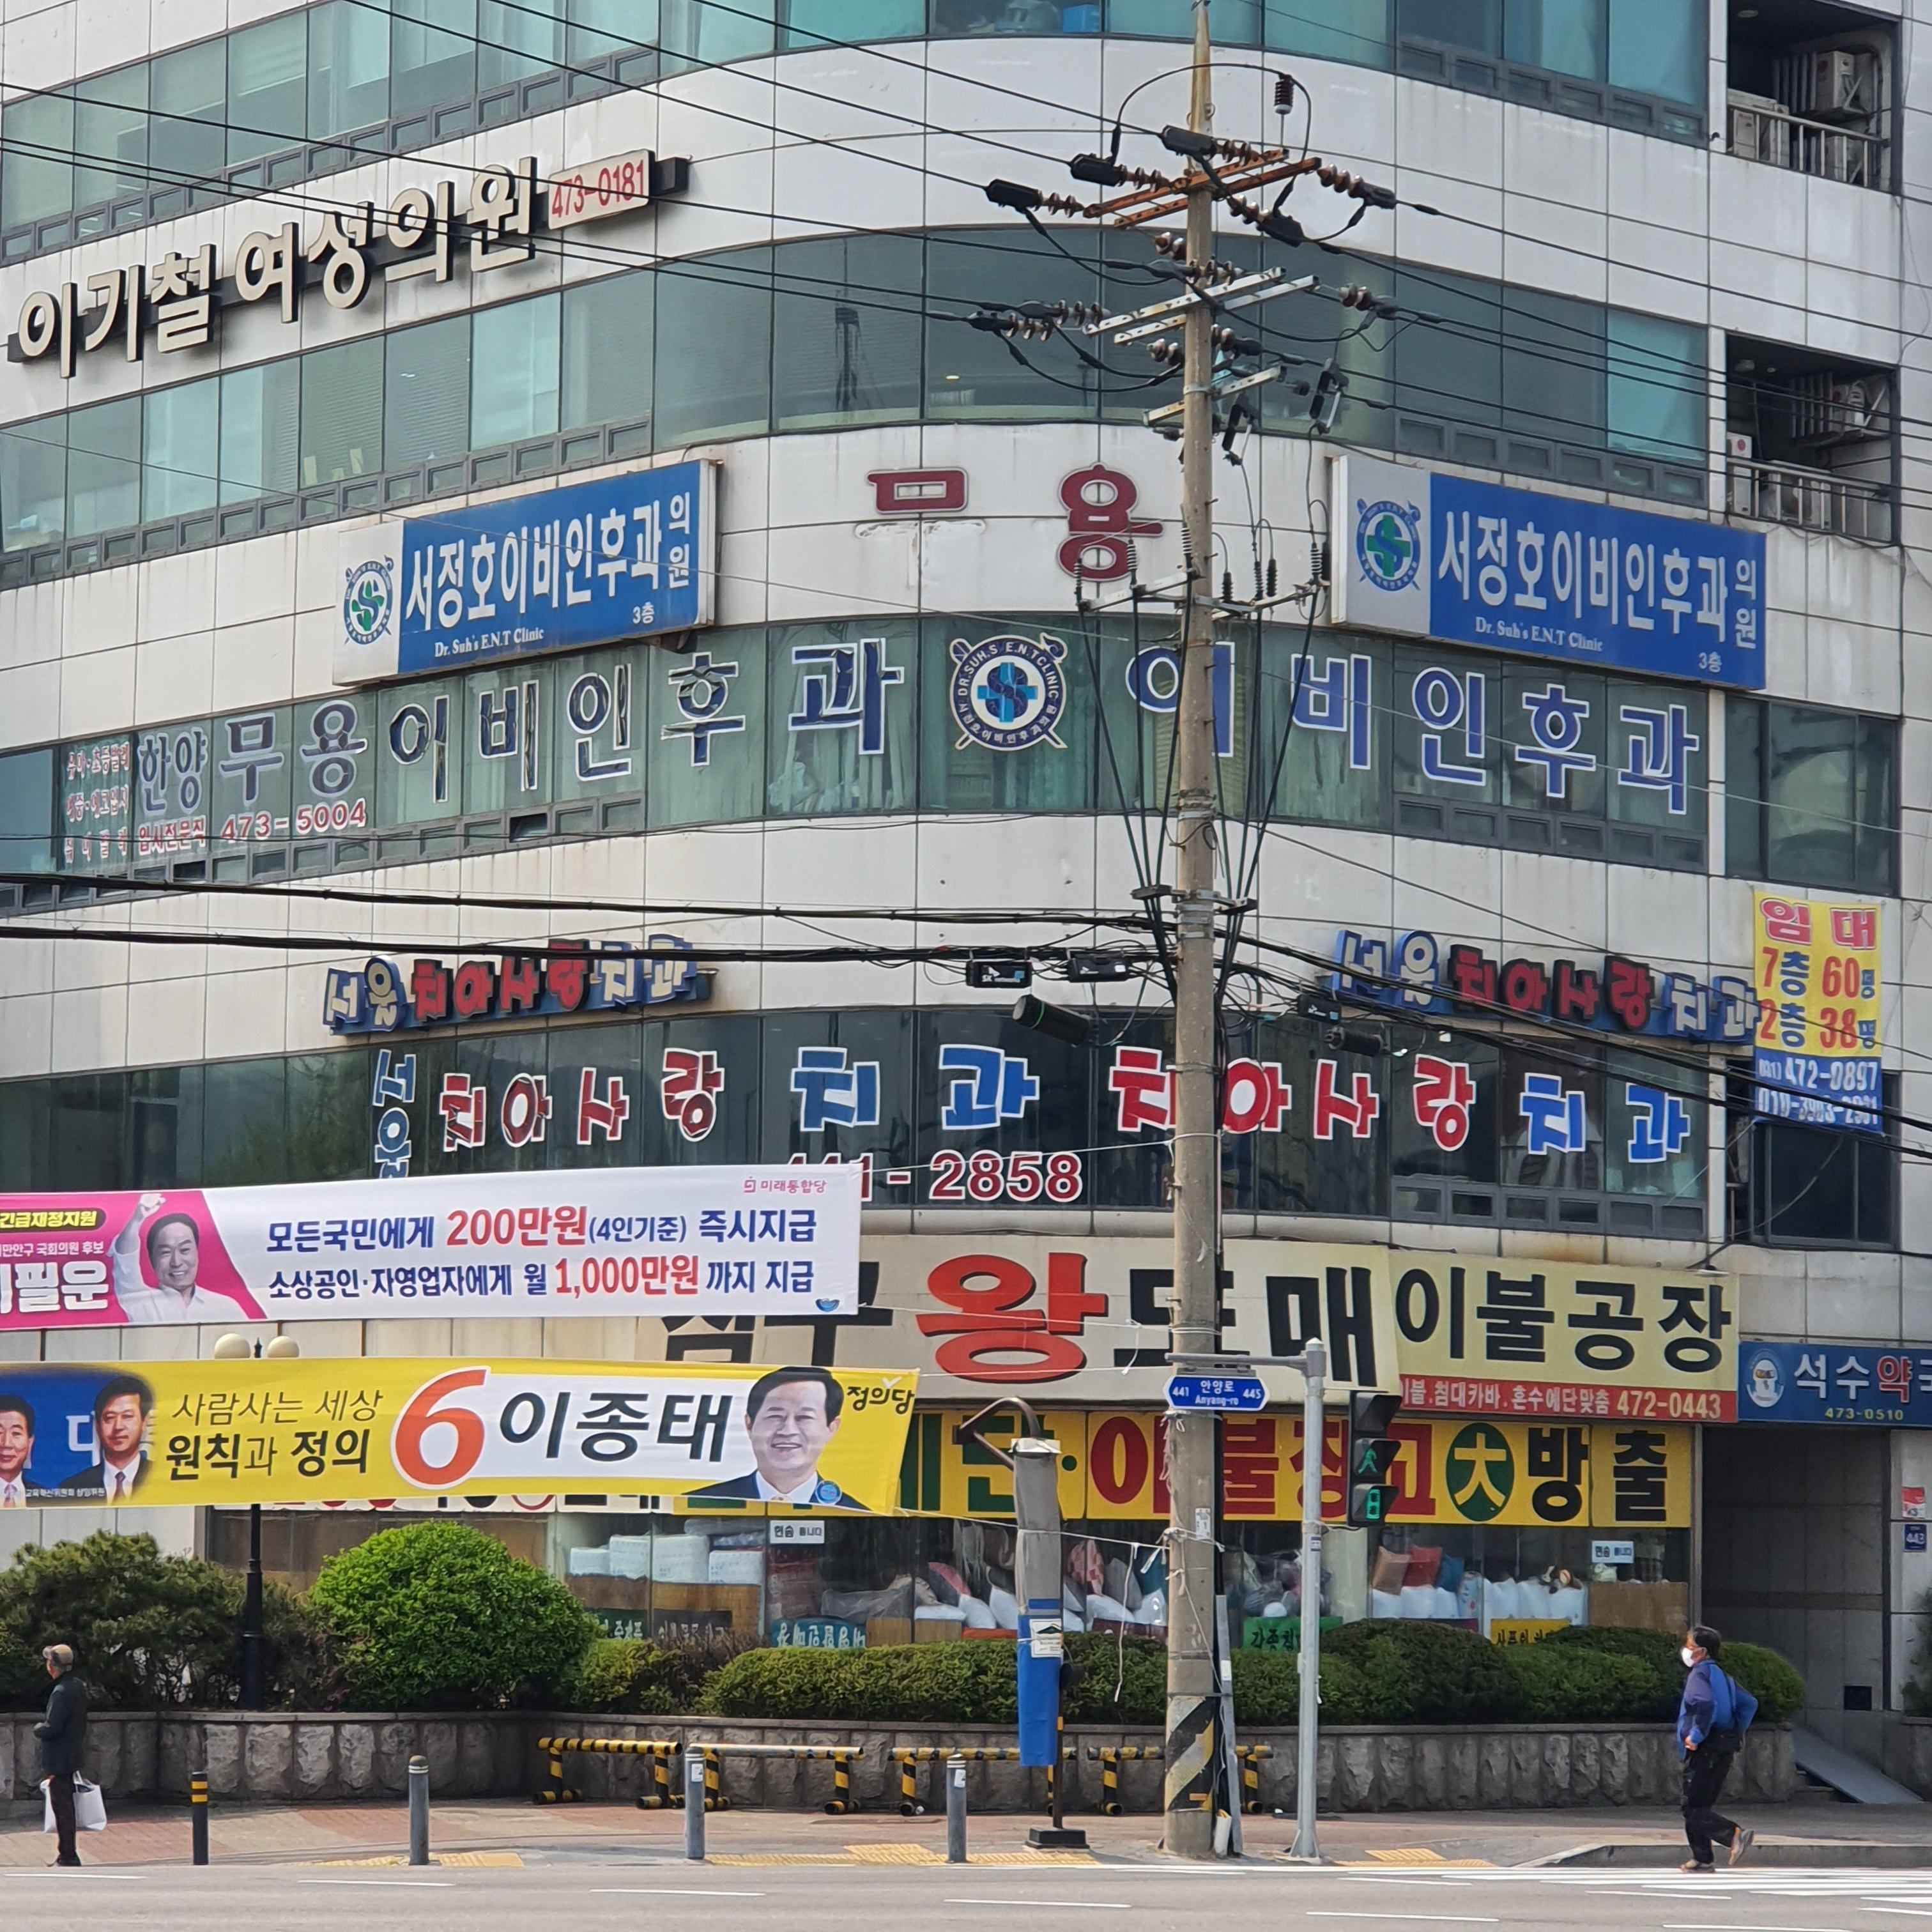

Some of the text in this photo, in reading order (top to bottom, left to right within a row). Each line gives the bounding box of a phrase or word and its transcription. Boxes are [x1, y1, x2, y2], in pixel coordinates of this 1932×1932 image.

[550, 158, 645, 218] 473-0181
[17, 156, 538, 379] 이기철 여성의원
[405, 500, 663, 631] 서정호이비인후과
[668, 491, 691, 589] 의원
[1438, 510, 1728, 643] 서정호이비인후과
[1735, 558, 1757, 650] 의원
[632, 601, 655, 625] 3층
[1475, 616, 1494, 635] Dr.
[1497, 619, 1528, 640] Suh's
[1568, 631, 1604, 654] Clinic
[434, 641, 450, 657] Dr.
[452, 634, 479, 655] Suh's
[513, 627, 544, 647] Clinic
[1698, 652, 1722, 673] 3층
[389, 638, 905, 804] 이비인후과
[1124, 641, 1700, 816] 이비인후과
[137, 699, 369, 816] 한양 무용
[220, 797, 367, 843] 473-5004
[1760, 898, 1876, 950] 임대
[1762, 946, 1876, 1000] 7층 60평
[1759, 999, 1877, 1050] 2층 38평
[760, 1179, 827, 1194] 미래통합당
[788, 1149, 1083, 1202] 1-2858
[0, 1211, 97, 1229] 긴급재정지원
[266, 1214, 435, 1253] 모든국민에게
[698, 1208, 816, 1243] 즉시지급
[0, 1241, 104, 1257] 만안구 국회의원 후보
[268, 1254, 815, 1301] 소상공인·자영업자에게 월 1,000만원 까지 지급
[1395, 1266, 1732, 1374] 이불공장
[171, 1388, 384, 1426] 사람사는 세상
[846, 1384, 916, 1417] 정의당
[1172, 1386, 1190, 1397] 441
[1195, 1394, 1239, 1406] Anyang-ro
[1200, 1379, 1235, 1395] 안양로
[1243, 1388, 1262, 1399] 445
[1616, 1390, 1722, 1420] 472-0443
[391, 1366, 732, 1491] 6 이종태
[1824, 1407, 1904, 1421] 473-0510
[165, 1428, 371, 1482] 원칙과 정의
